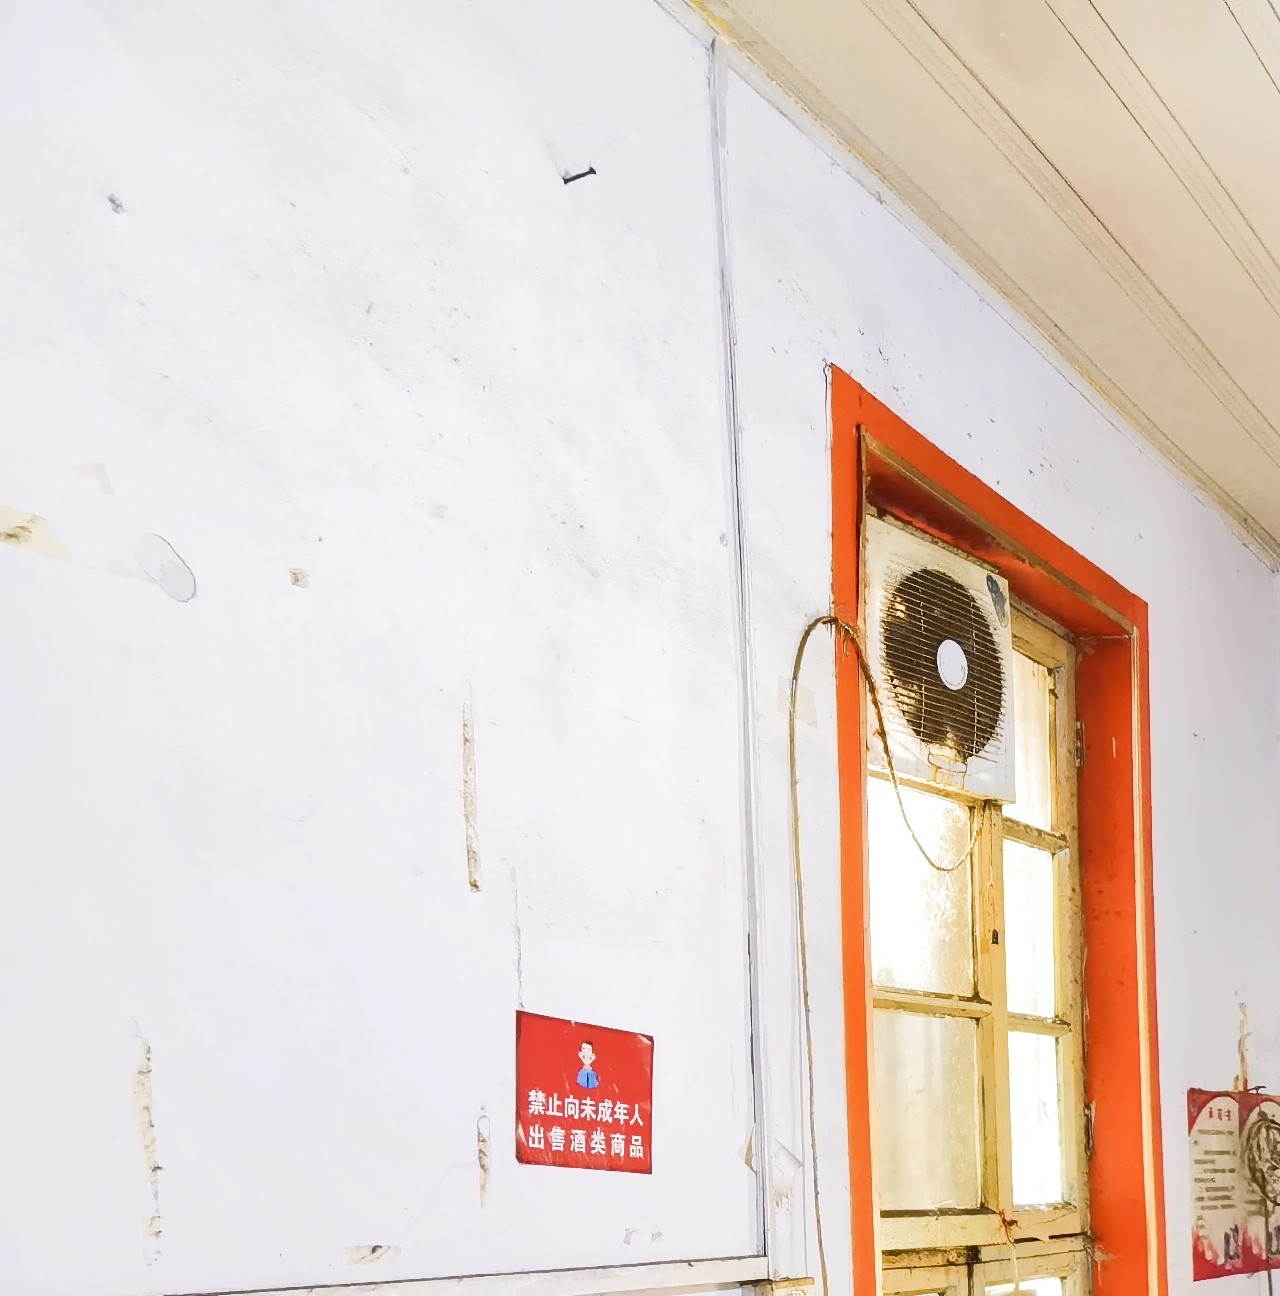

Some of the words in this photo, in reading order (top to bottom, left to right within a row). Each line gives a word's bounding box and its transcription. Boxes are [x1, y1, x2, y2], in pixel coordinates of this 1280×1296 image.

[527, 1089, 644, 1126] 禁止向未成年人
[528, 1124, 644, 1159] 出售酒类商品
